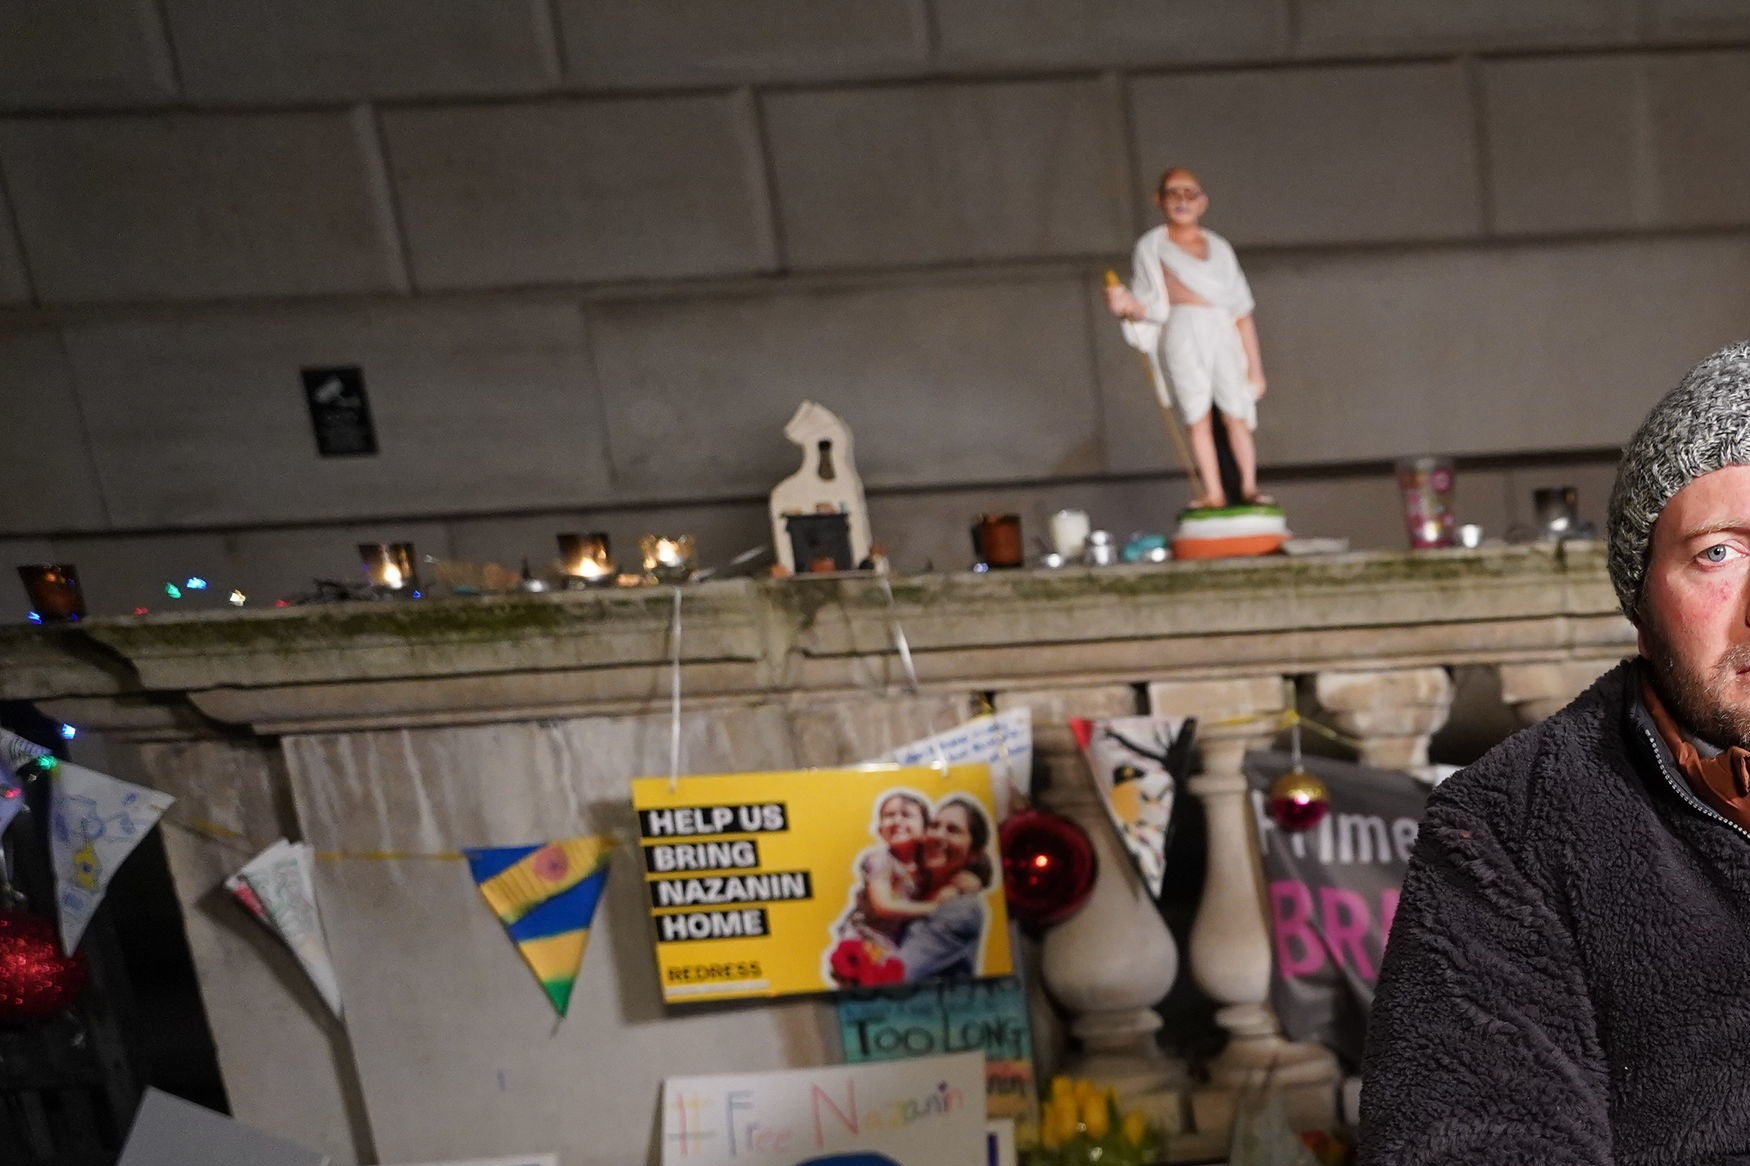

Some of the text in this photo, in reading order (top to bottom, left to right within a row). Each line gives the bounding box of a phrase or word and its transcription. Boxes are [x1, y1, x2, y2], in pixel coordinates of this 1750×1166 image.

[648, 803, 785, 837] HELP US
[653, 840, 756, 871] BRING
[657, 873, 807, 905] NAZANIN
[662, 910, 763, 941] HOME
[667, 961, 762, 982] REDRESS
